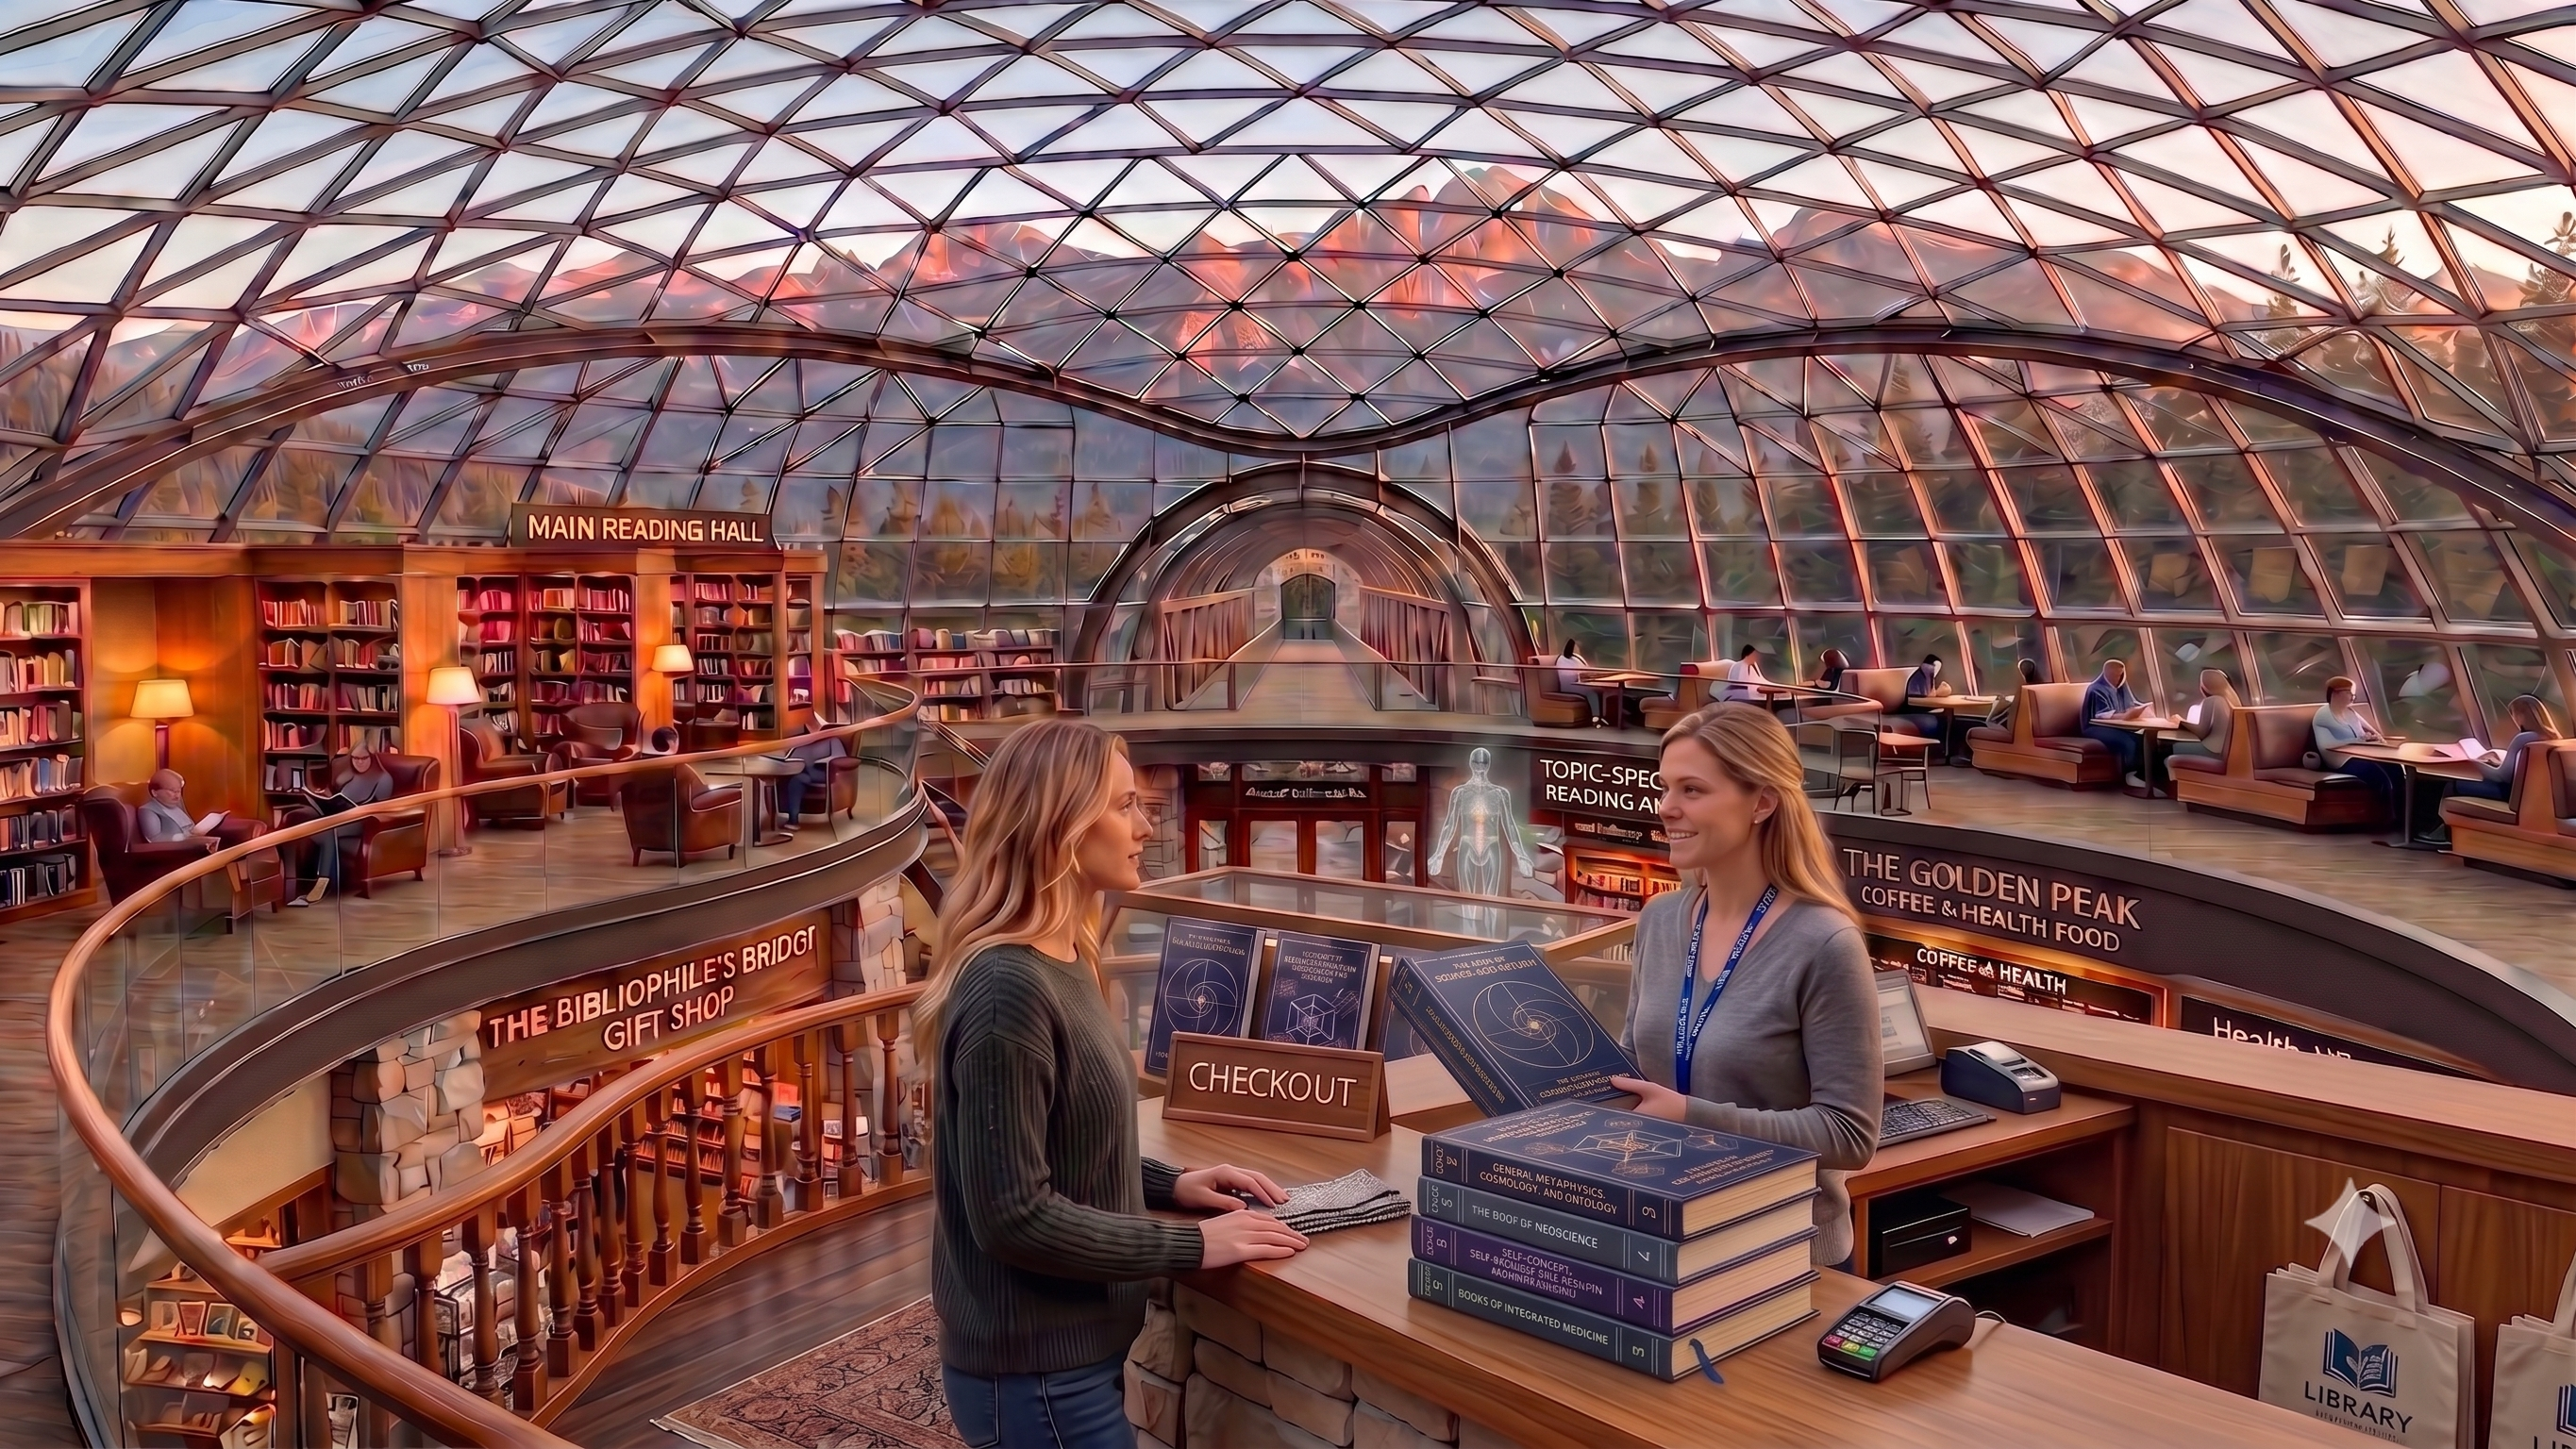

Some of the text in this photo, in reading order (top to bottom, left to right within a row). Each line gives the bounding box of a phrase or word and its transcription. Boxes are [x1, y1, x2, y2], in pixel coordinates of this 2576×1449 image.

[528, 514, 764, 542] MAIN READING HALL
[1546, 785, 1634, 810] READING
[1843, 848, 2142, 930] THE GOLDEN PEAK
[1862, 886, 2120, 952] COFFEE & HEALTH FOOD
[1917, 948, 1977, 974] COFFEE
[1999, 963, 2066, 995] HEALTH
[490, 1005, 548, 1048] THE
[556, 952, 736, 1028] BIBLIOPHILE'S
[604, 985, 734, 1051] GIFT SHOP
[1189, 1061, 1358, 1108] CHECKOUT
[1493, 1162, 1533, 1182] GENERAL
[1544, 1187, 1564, 1202] AND
[1564, 1193, 1617, 1215] ONTOLOGY
[1472, 1205, 1490, 1218] THE
[1535, 1222, 1598, 1250] NEOSCIENCE
[1458, 1288, 1489, 1307] BOOKS
[1504, 1303, 1561, 1329] INTEGRATED
[1563, 1322, 1609, 1345] MEDICINE
[2304, 1380, 2414, 1434] LIBRARY
